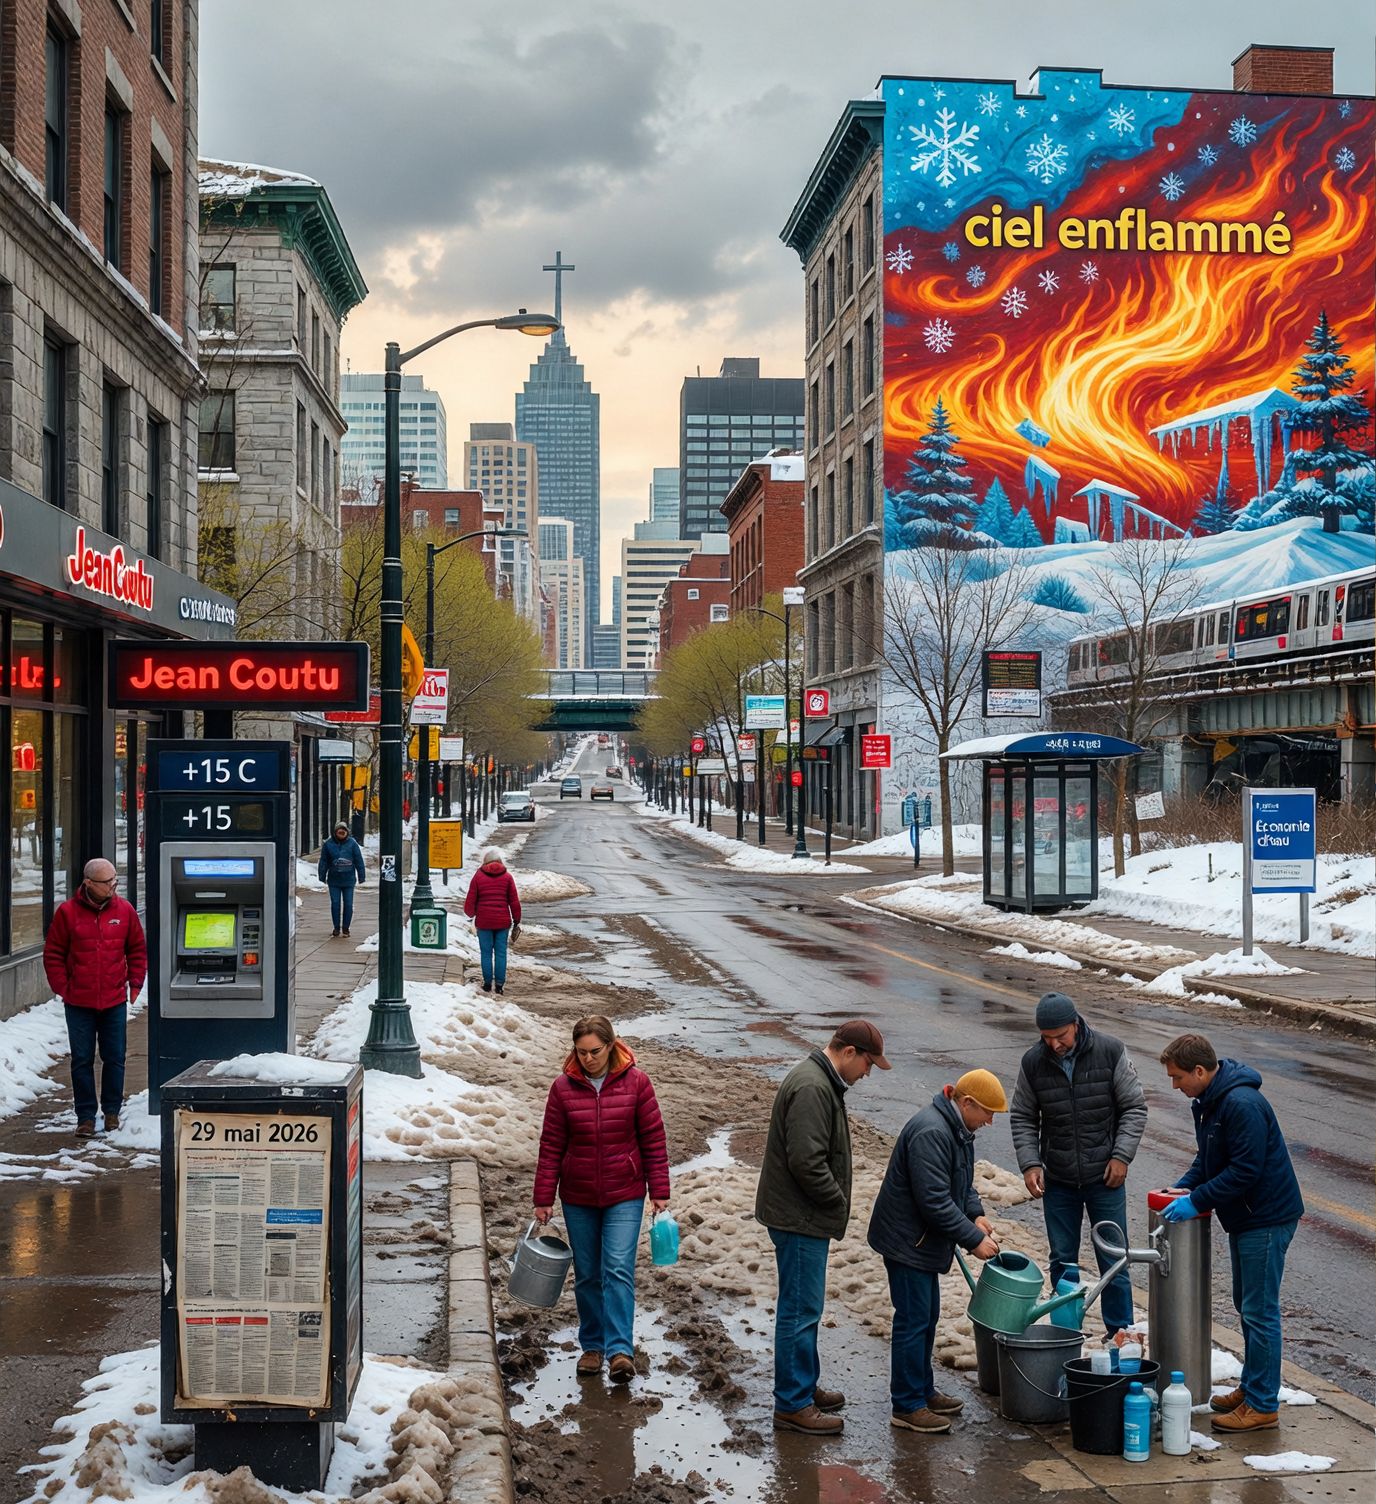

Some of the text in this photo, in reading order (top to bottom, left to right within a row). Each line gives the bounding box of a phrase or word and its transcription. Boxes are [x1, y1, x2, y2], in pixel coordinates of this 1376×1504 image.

[964, 204, 1291, 254] ciel enflammé
[68, 526, 113, 596] Jean
[129, 658, 339, 690] Jean Coutu
[182, 758, 256, 783] +15 C
[182, 805, 232, 830] +15
[190, 1121, 319, 1143] 29 mai 2026
